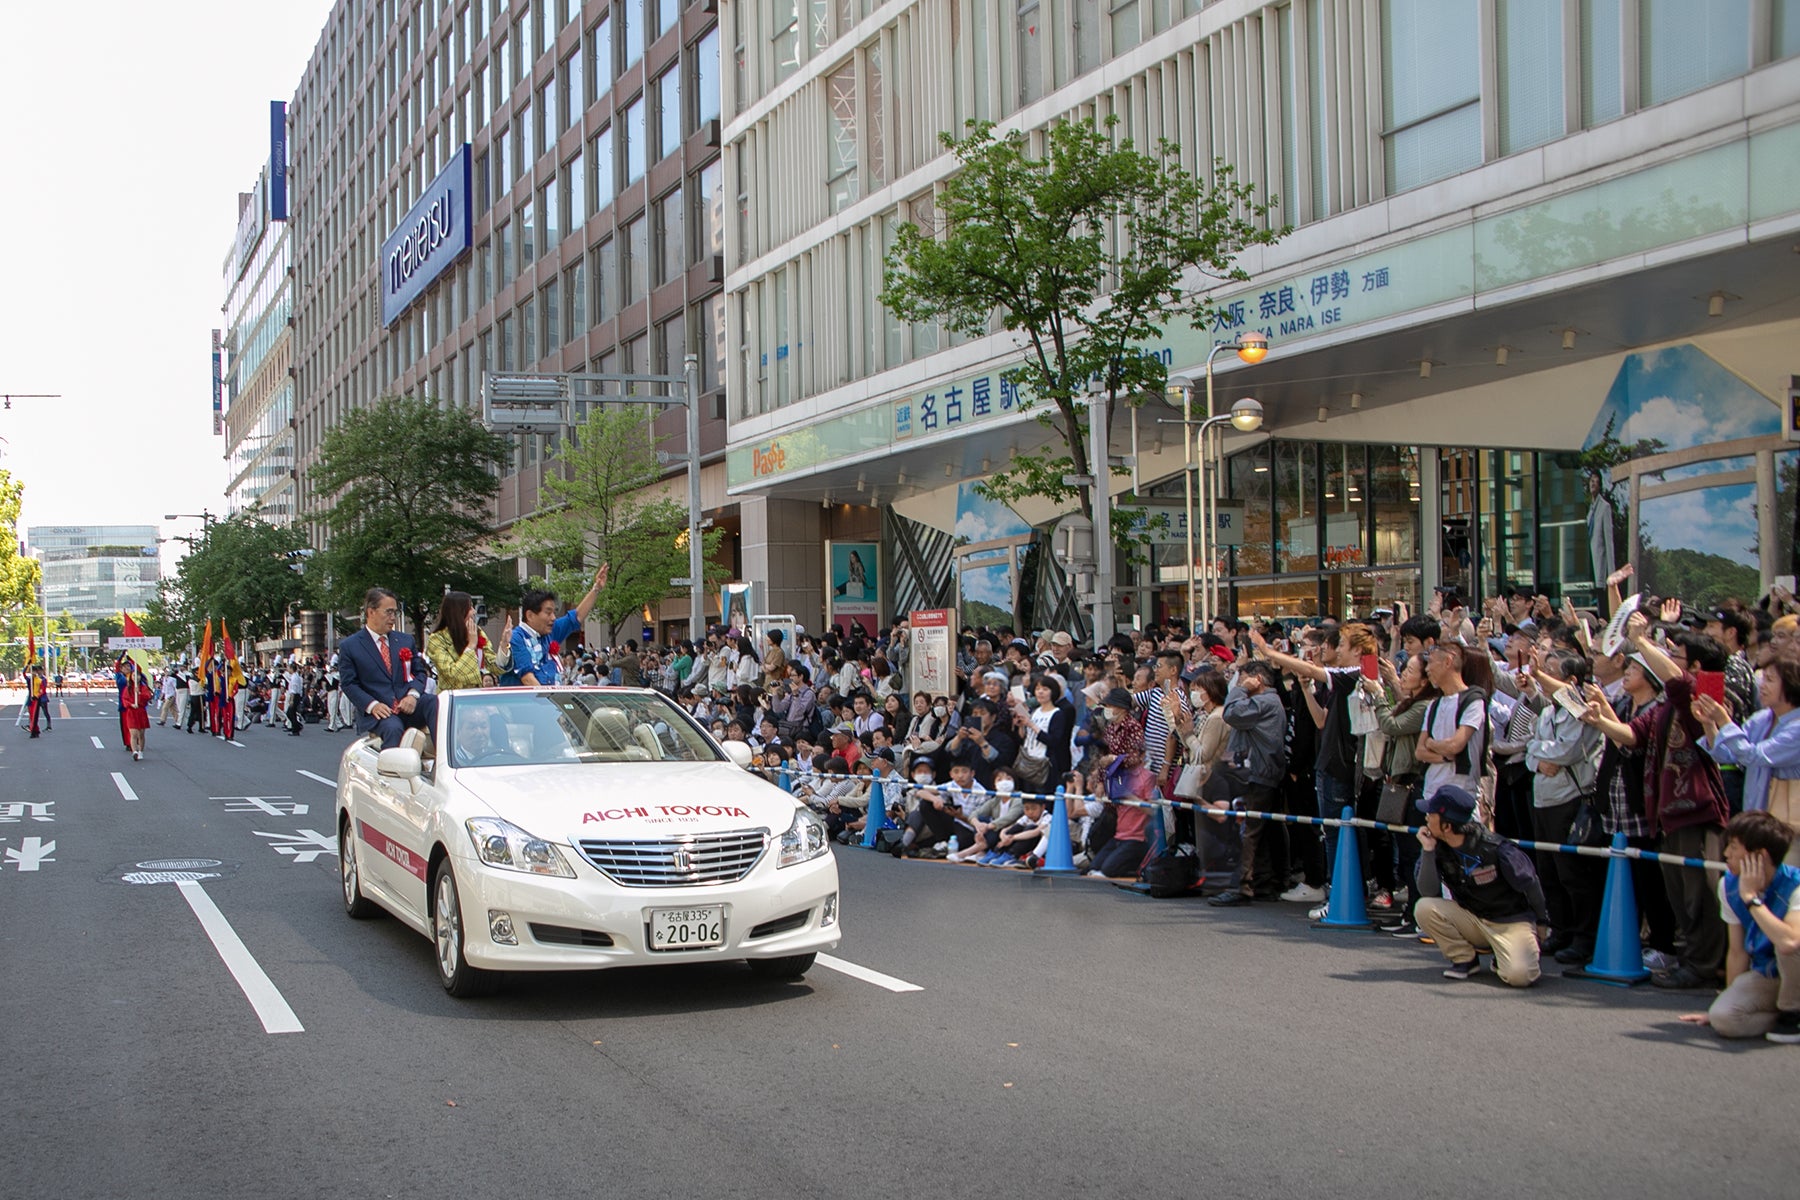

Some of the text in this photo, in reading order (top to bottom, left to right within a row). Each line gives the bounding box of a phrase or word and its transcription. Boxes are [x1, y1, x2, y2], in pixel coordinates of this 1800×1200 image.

[389, 189, 451, 294] meitetsu
[1362, 267, 1389, 293] 方面
[1280, 315, 1314, 336] NARA
[1321, 308, 1342, 326] ISE
[920, 368, 1021, 431] 名古屋駅
[582, 805, 750, 825] AICHI TOYOTA
[655, 922, 720, 944] な 20-06
